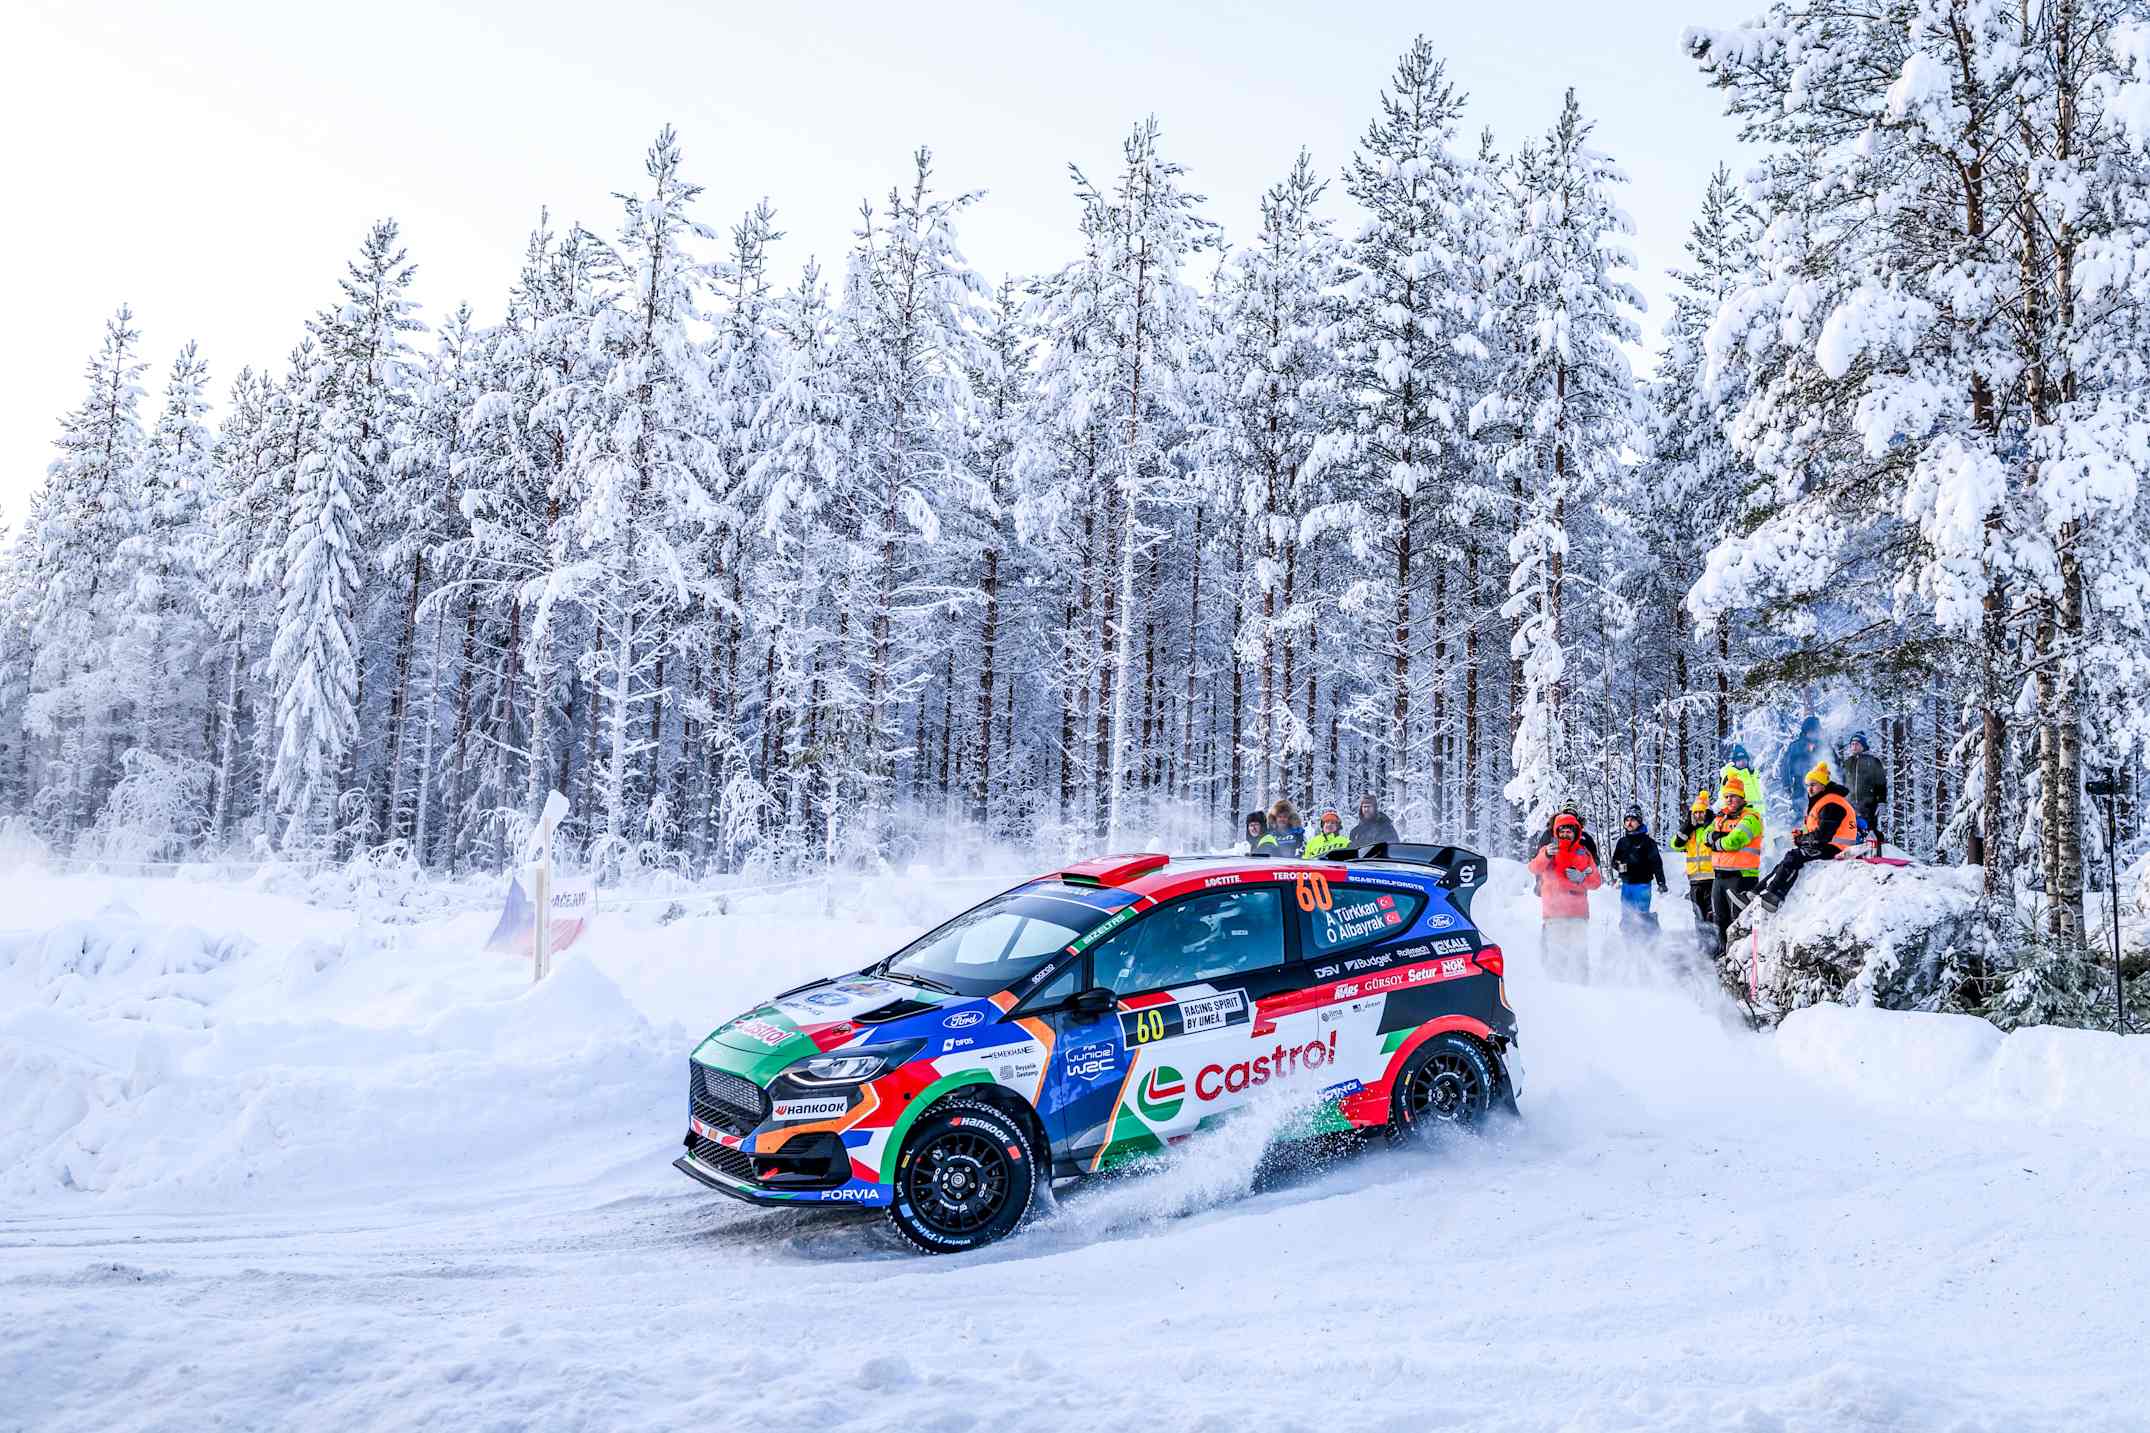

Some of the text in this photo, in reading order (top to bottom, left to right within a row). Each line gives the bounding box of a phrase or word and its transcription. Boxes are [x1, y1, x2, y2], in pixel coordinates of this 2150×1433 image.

[1296, 871, 1333, 912] 60
[1326, 903, 1379, 927] A Türkkan
[1327, 914, 1385, 943] O Albayrak
[1357, 953, 1391, 969] Budget
[1314, 964, 1340, 979] DSV
[1408, 967, 1437, 982] Setur
[1364, 975, 1404, 991] GÜRSOY
[1184, 997, 1239, 1016] RACING SPIRIT
[949, 1012, 979, 1027] Ford
[1137, 1009, 1165, 1043] 60
[1187, 1019, 1197, 1029] BY
[1066, 1058, 1115, 1076] WRC
[1195, 1030, 1337, 1101] Castrol
[821, 1188, 880, 1200] FORVIA
